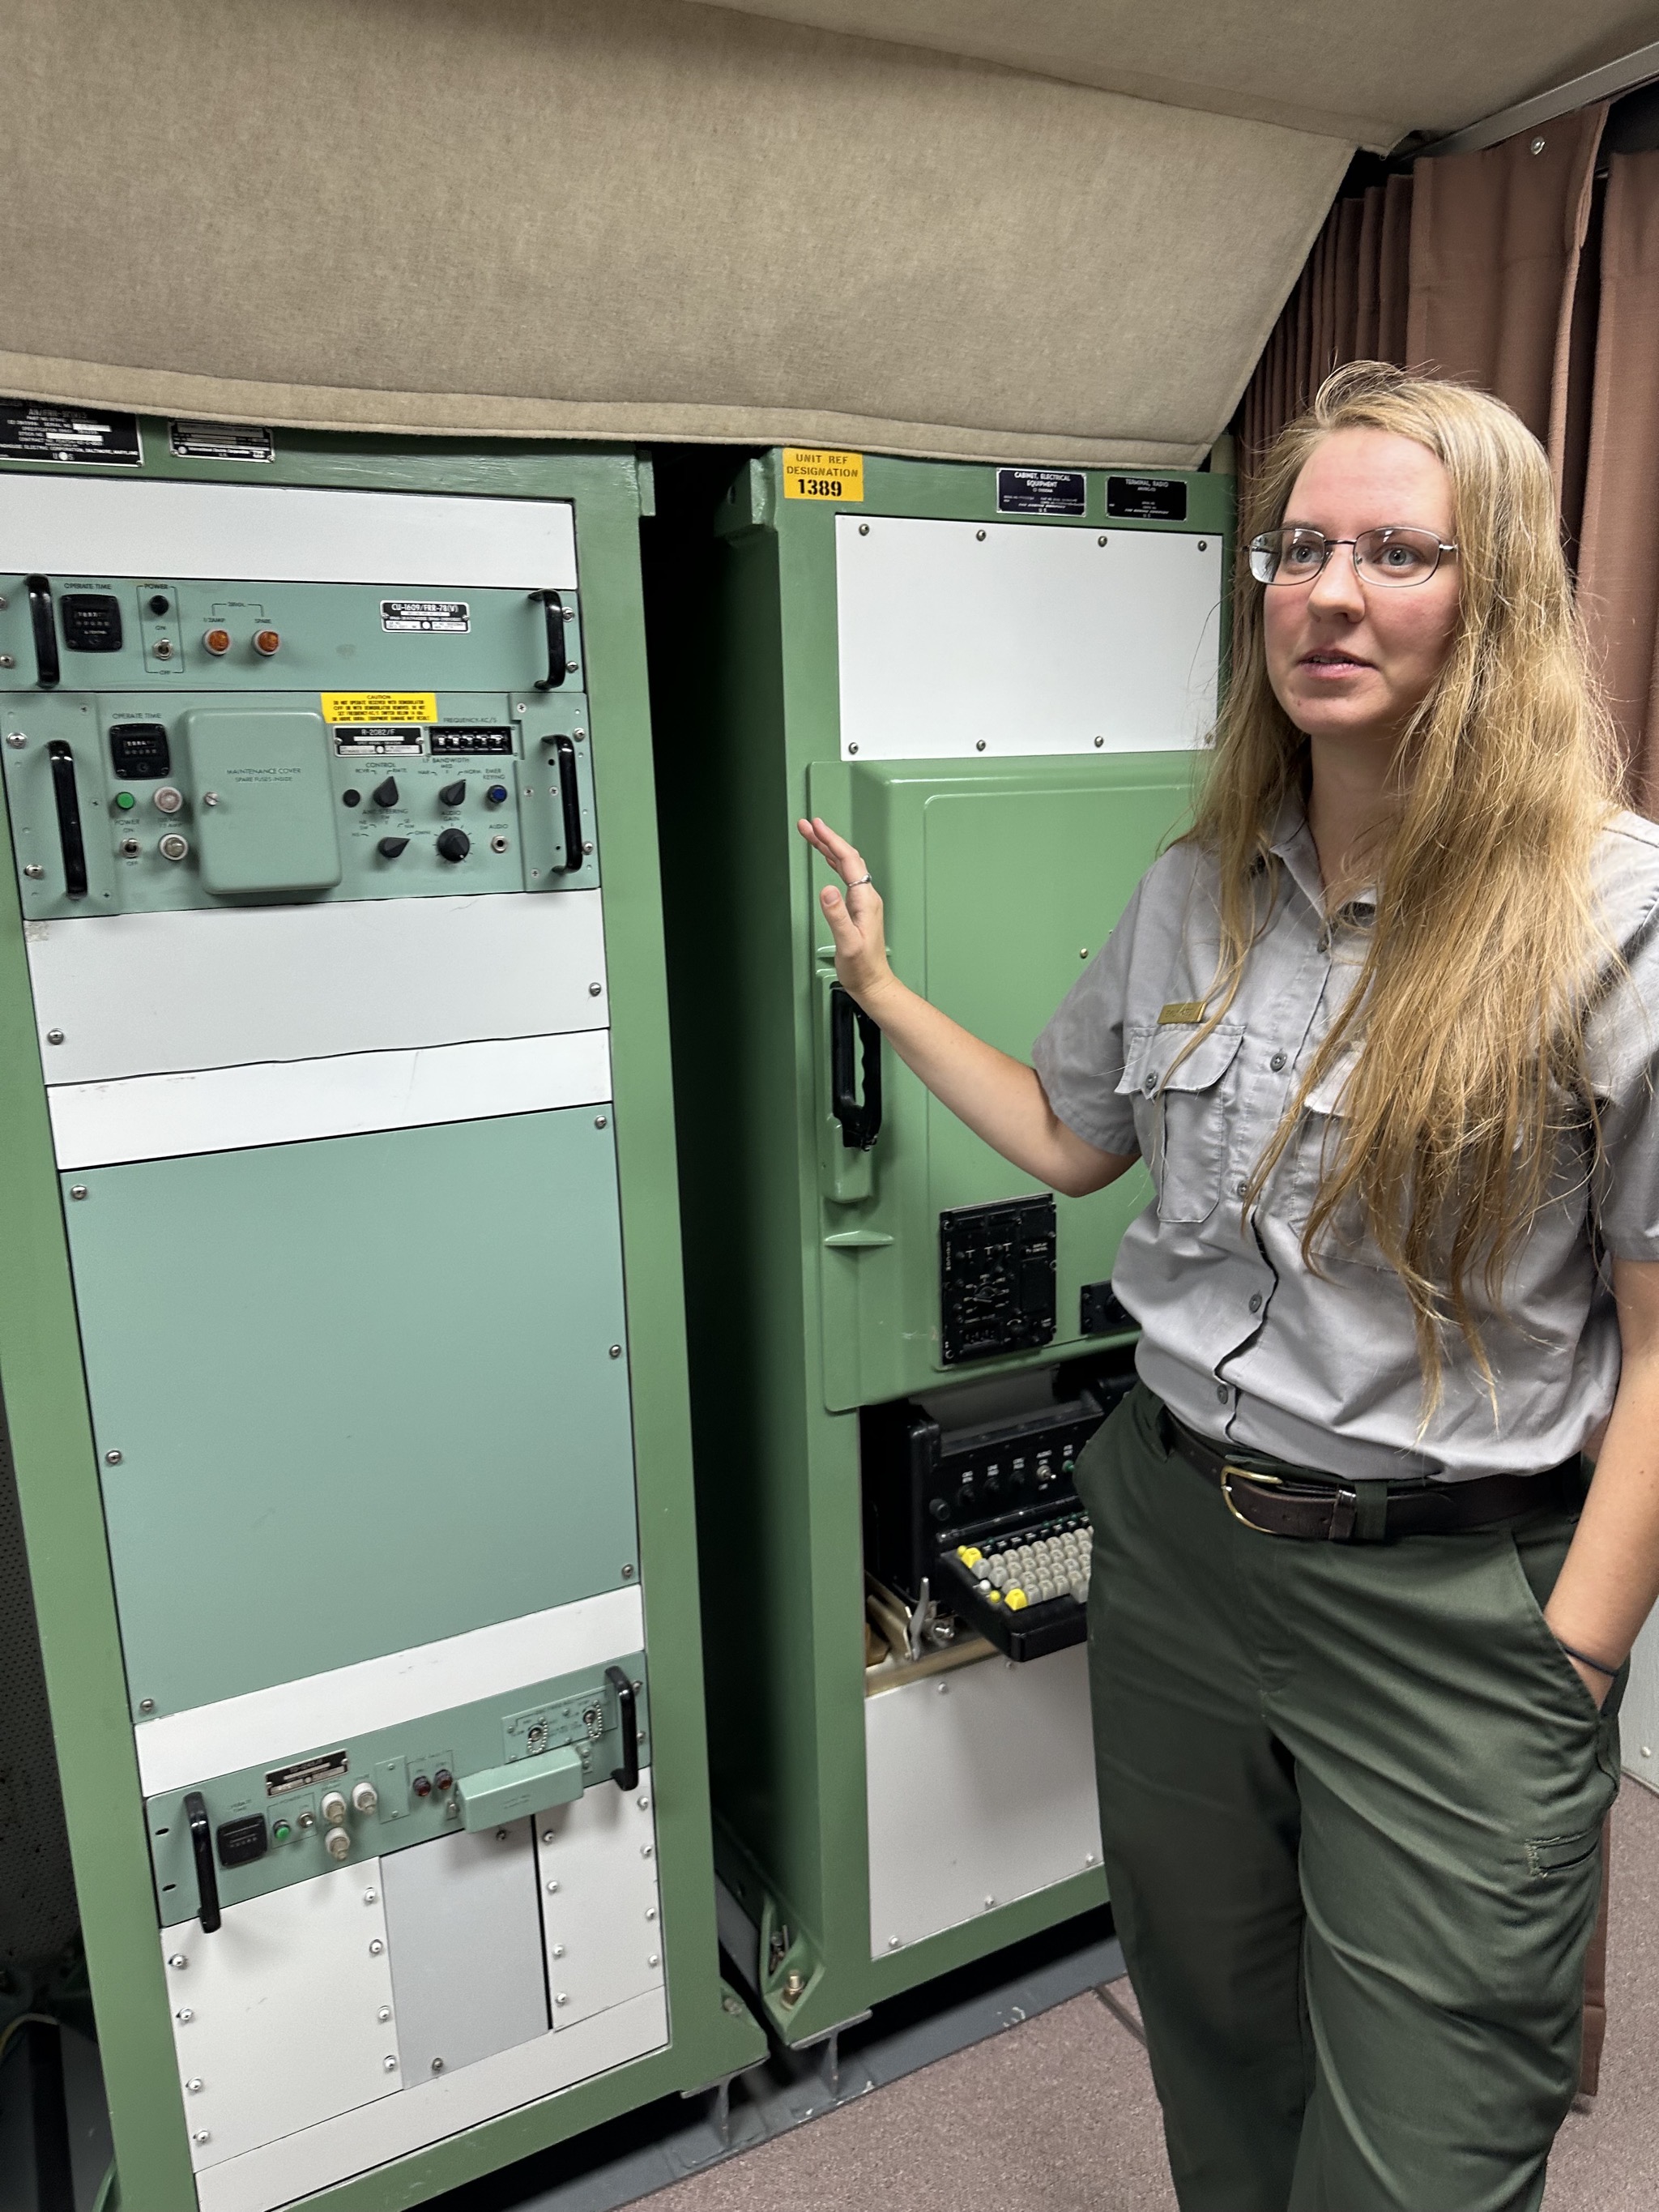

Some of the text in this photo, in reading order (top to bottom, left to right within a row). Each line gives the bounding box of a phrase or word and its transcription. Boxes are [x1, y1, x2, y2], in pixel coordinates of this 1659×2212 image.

[795, 454, 848, 464] UNIT REF
[787, 466, 858, 477] DESIGNATION
[1014, 472, 1071, 481] CABINET, ELECTRICAL
[798, 479, 842, 497] 1389
[1026, 480, 1058, 488] EQUIPMENT
